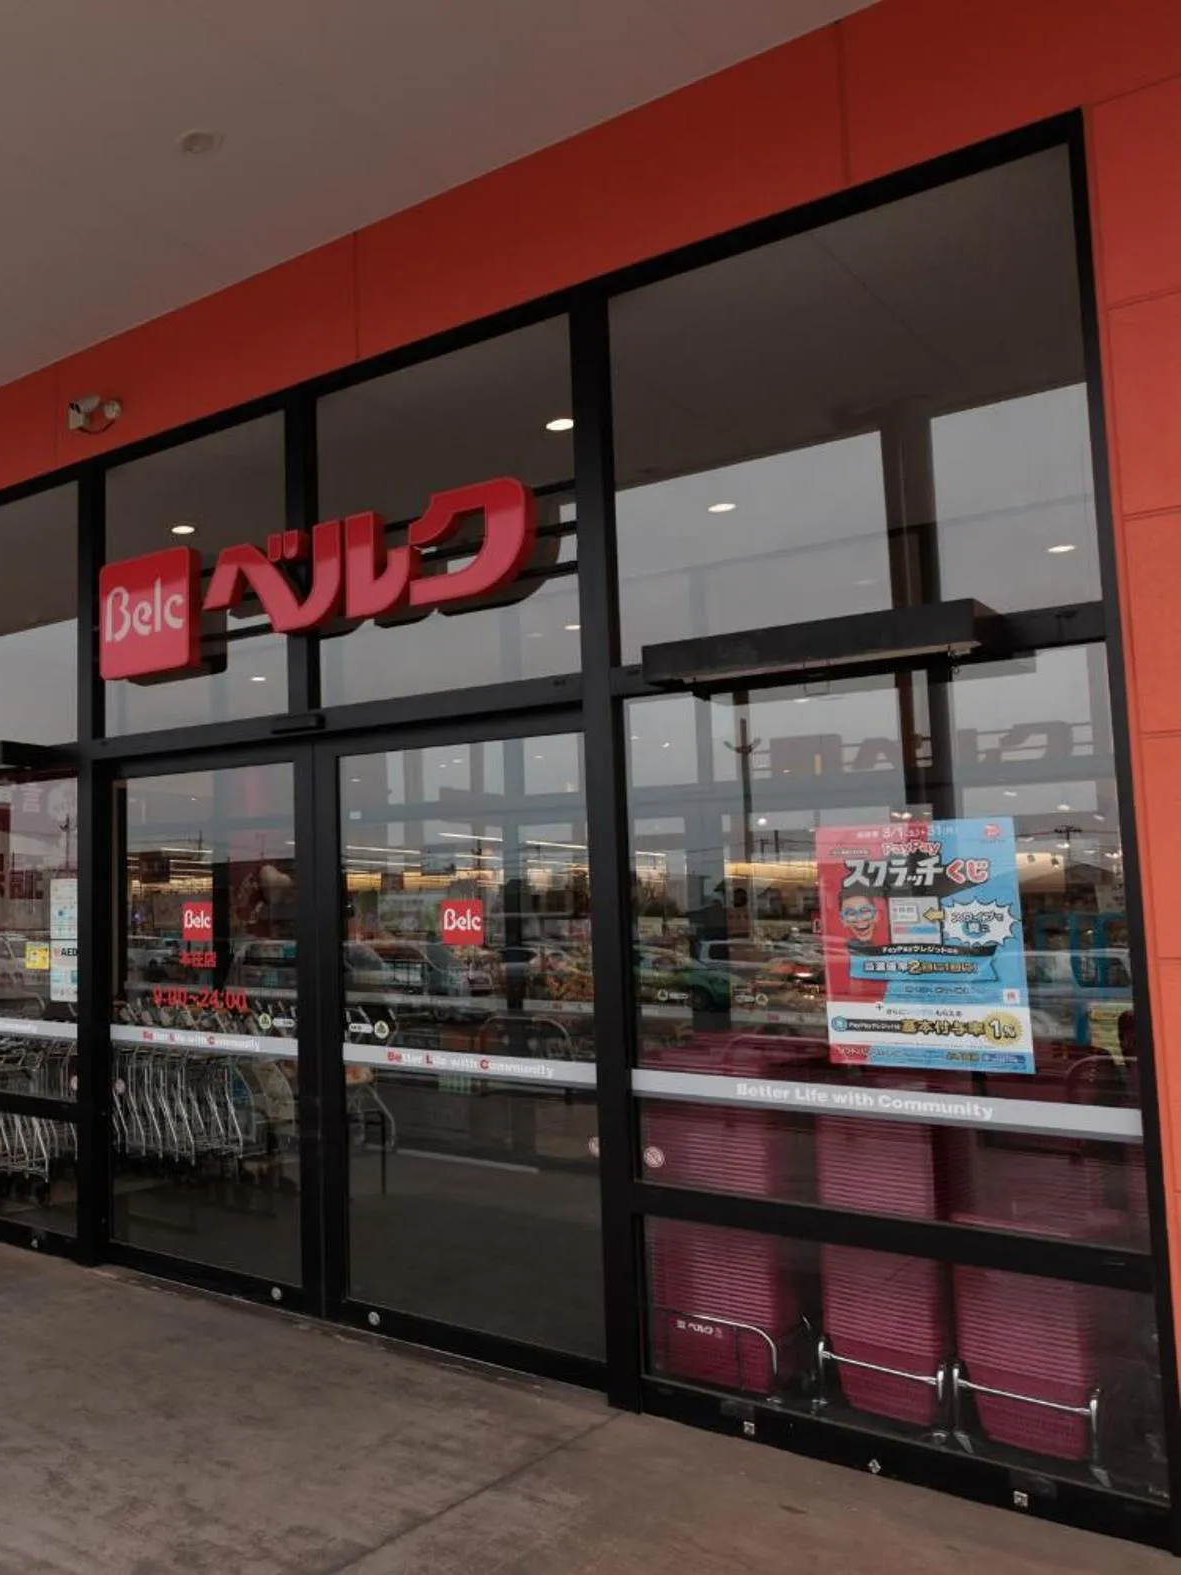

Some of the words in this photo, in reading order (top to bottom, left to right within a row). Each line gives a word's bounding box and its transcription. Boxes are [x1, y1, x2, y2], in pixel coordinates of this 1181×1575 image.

[203, 476, 537, 633] ベルク
[105, 577, 185, 643] Belc
[881, 841, 941, 856] PayPay
[843, 858, 990, 888] スクラッチくじ
[184, 909, 212, 929] Belc
[444, 908, 481, 931] Belc
[736, 1083, 790, 1100] Better
[795, 1086, 828, 1103] Life
[831, 1090, 874, 1107] with
[878, 1094, 994, 1121] Community
